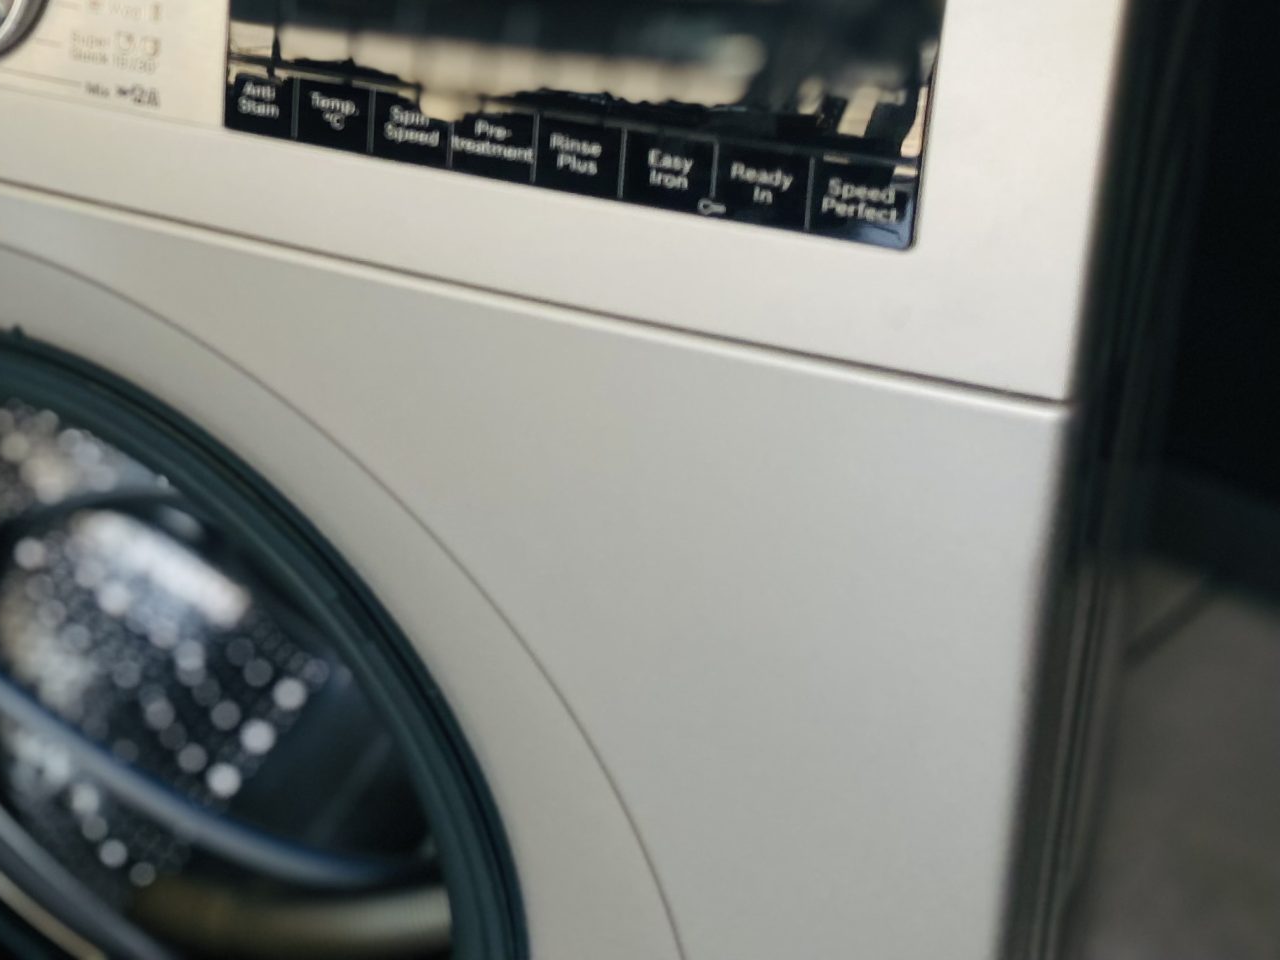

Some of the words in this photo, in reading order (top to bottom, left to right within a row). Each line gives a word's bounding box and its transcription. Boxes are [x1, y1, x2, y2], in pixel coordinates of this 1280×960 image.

[243, 80, 276, 101] Anti
[311, 90, 360, 117] Temp.
[238, 95, 280, 119] Stain
[390, 104, 430, 127] Spin
[384, 121, 440, 147] Speed
[549, 131, 602, 158] Rinse
[451, 134, 534, 164] treatment
[648, 148, 694, 176] Easy
[557, 151, 598, 175] Plus
[730, 160, 793, 190] Ready
[649, 169, 688, 190] Iron
[828, 175, 896, 205] Speed
[753, 184, 773, 204] In
[822, 194, 897, 223] Perfect
